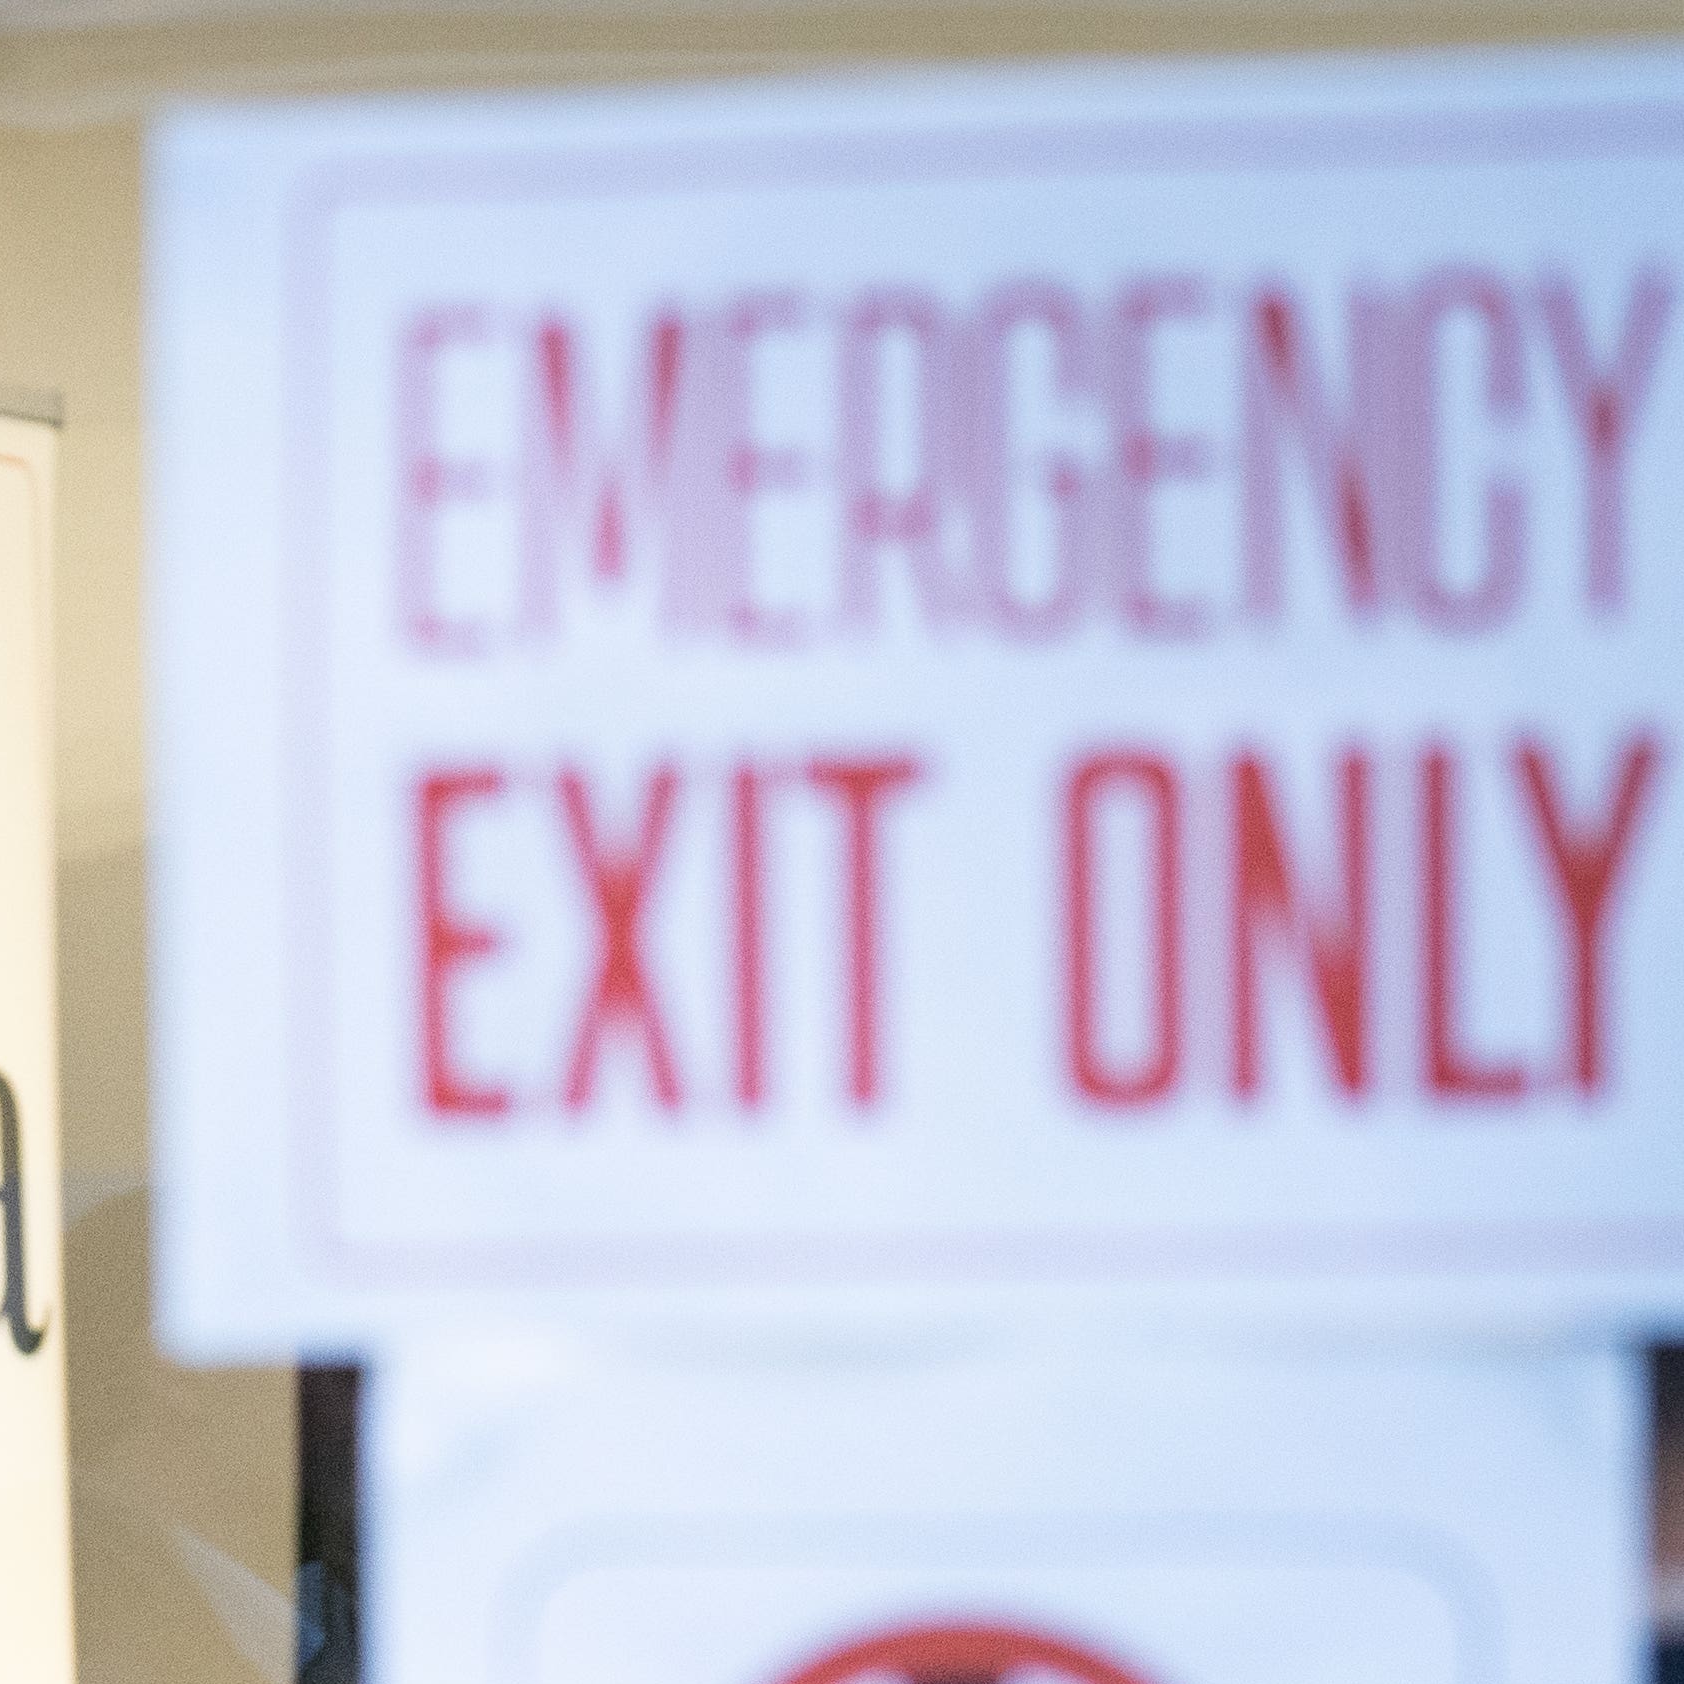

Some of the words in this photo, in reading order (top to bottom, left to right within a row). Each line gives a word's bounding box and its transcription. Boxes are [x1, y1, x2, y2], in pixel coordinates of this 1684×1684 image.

[393, 259, 1681, 662] EMERGENCY
[406, 742, 931, 1130] EXIT
[1061, 718, 1669, 1117] ONLY
